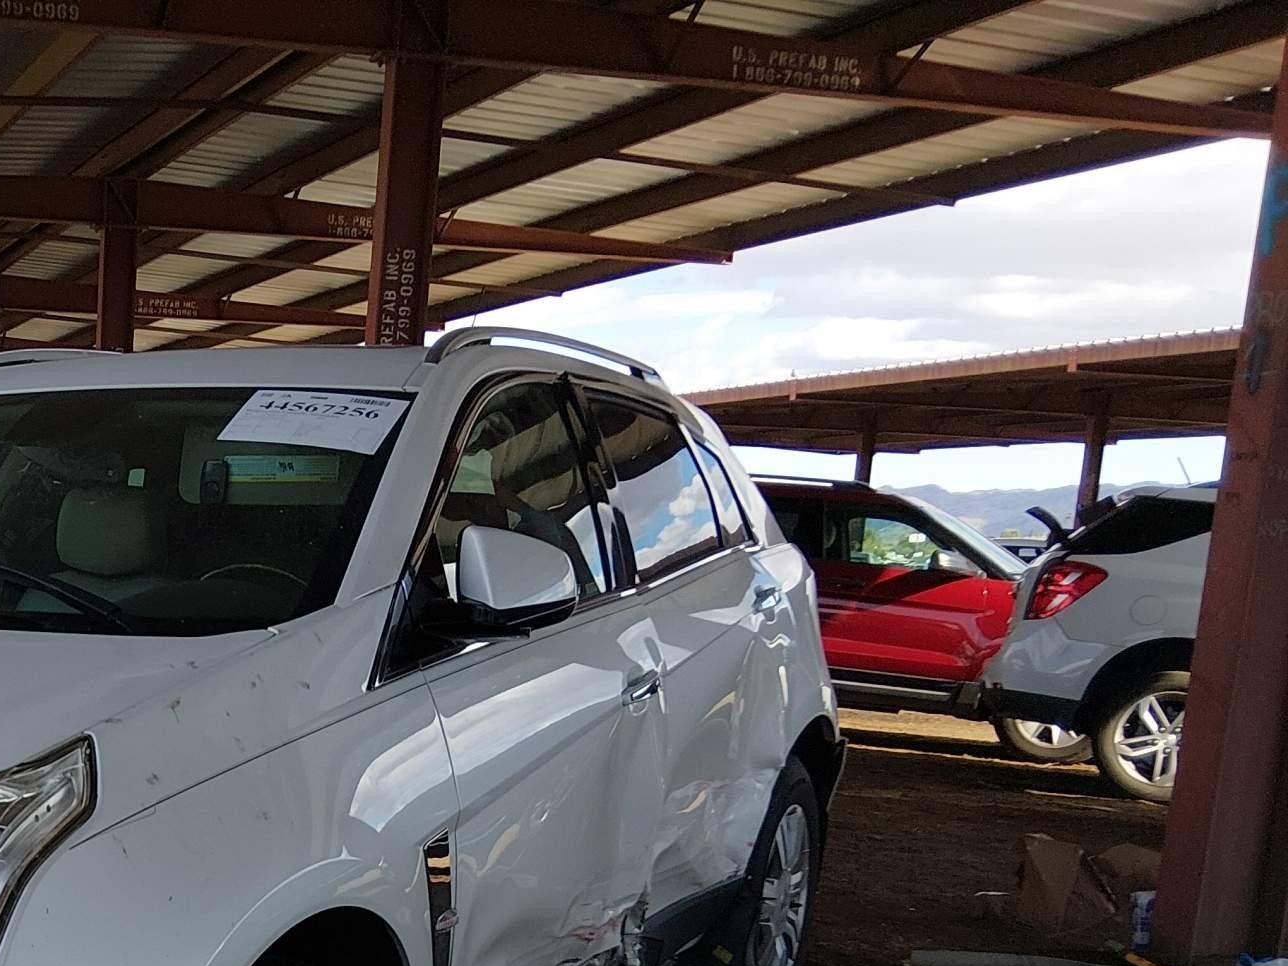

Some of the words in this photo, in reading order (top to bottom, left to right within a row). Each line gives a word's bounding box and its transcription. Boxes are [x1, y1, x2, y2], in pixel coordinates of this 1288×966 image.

[732, 45, 761, 64] U.S.
[768, 49, 828, 71] PREFAB
[352, 216, 373, 227] PRE
[386, 247, 401, 280] INC.
[396, 249, 416, 342] 799-0969
[380, 290, 397, 346] REFAB
[259, 400, 380, 420] 44567256
